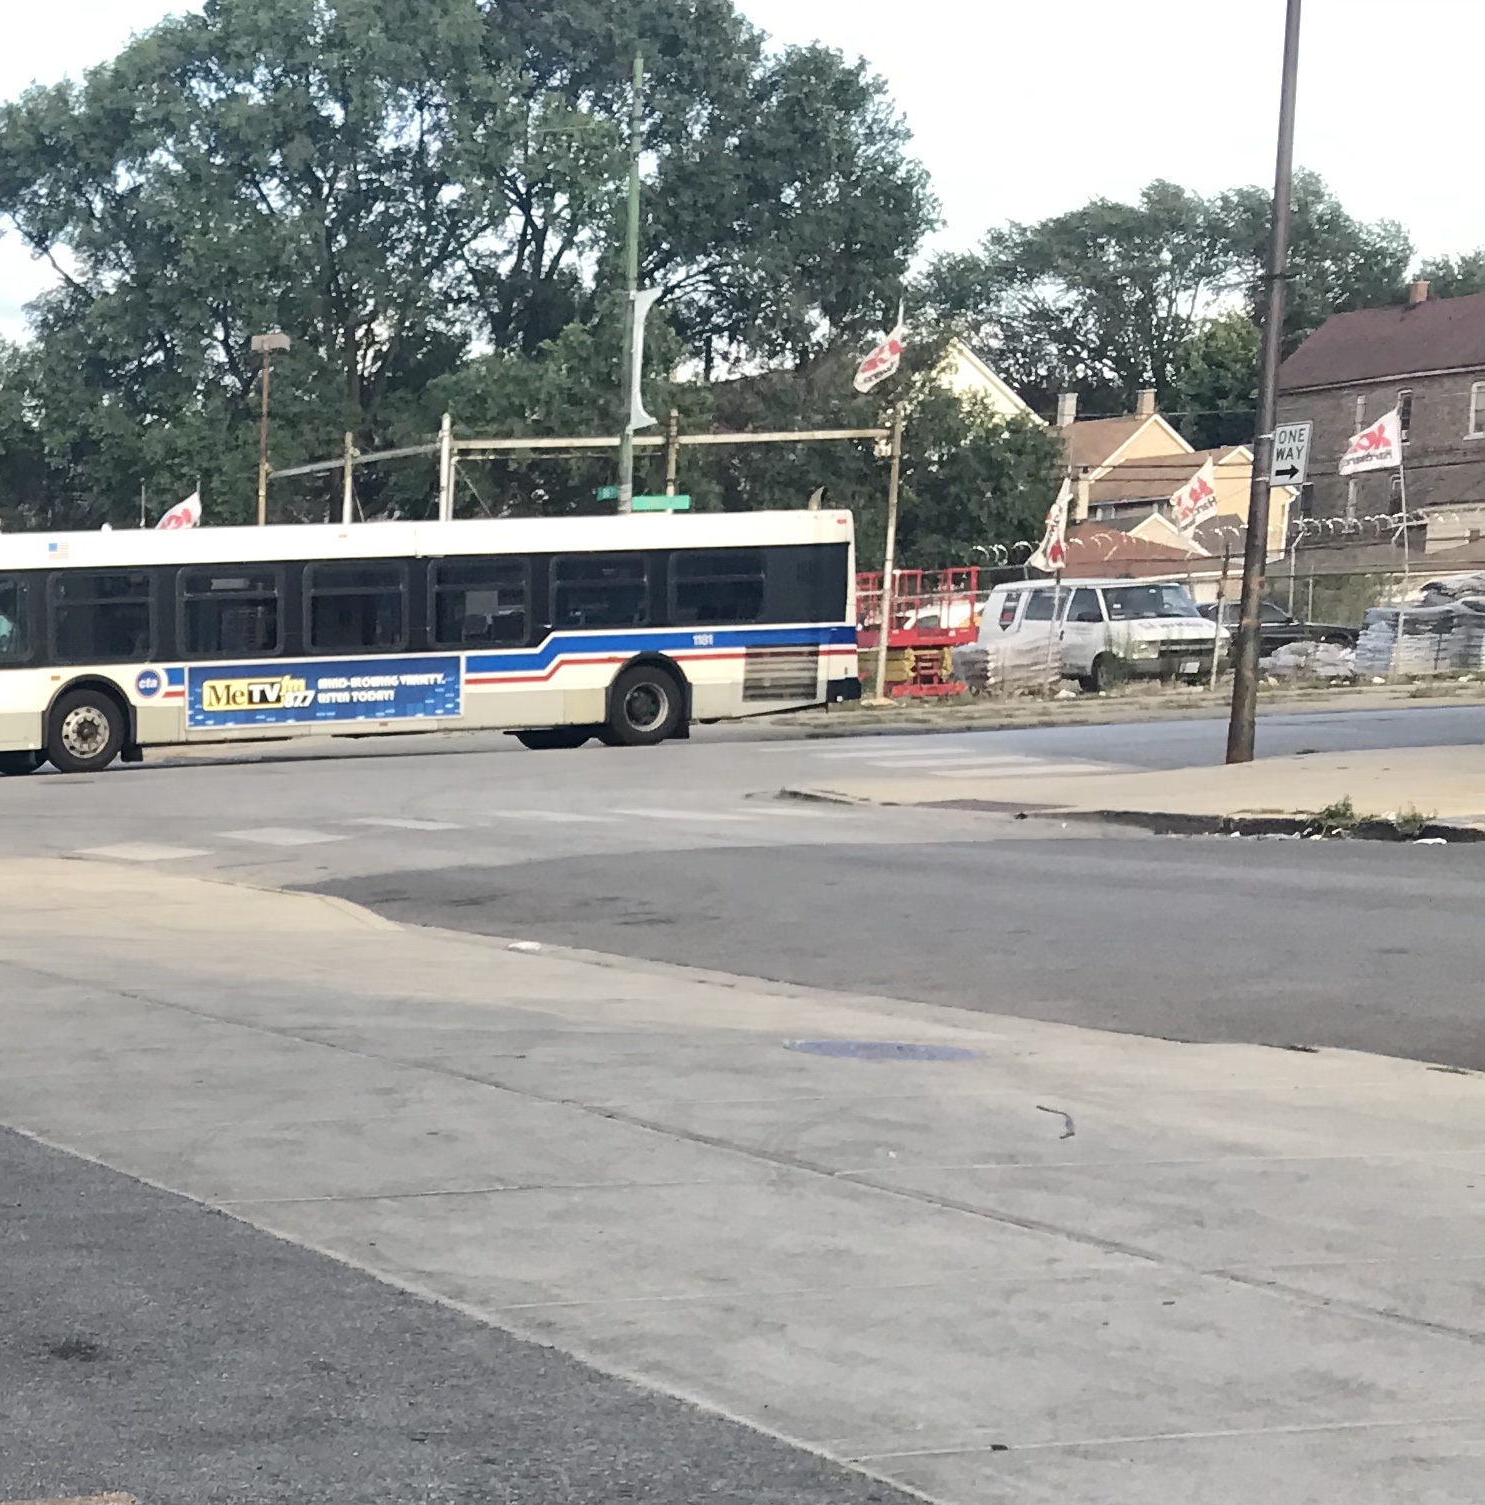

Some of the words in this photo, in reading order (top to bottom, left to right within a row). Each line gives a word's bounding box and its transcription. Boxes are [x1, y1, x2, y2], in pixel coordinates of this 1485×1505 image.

[1278, 428, 1306, 444] ONE
[1276, 446, 1304, 461] WAY
[351, 689, 395, 703] TODAY!
